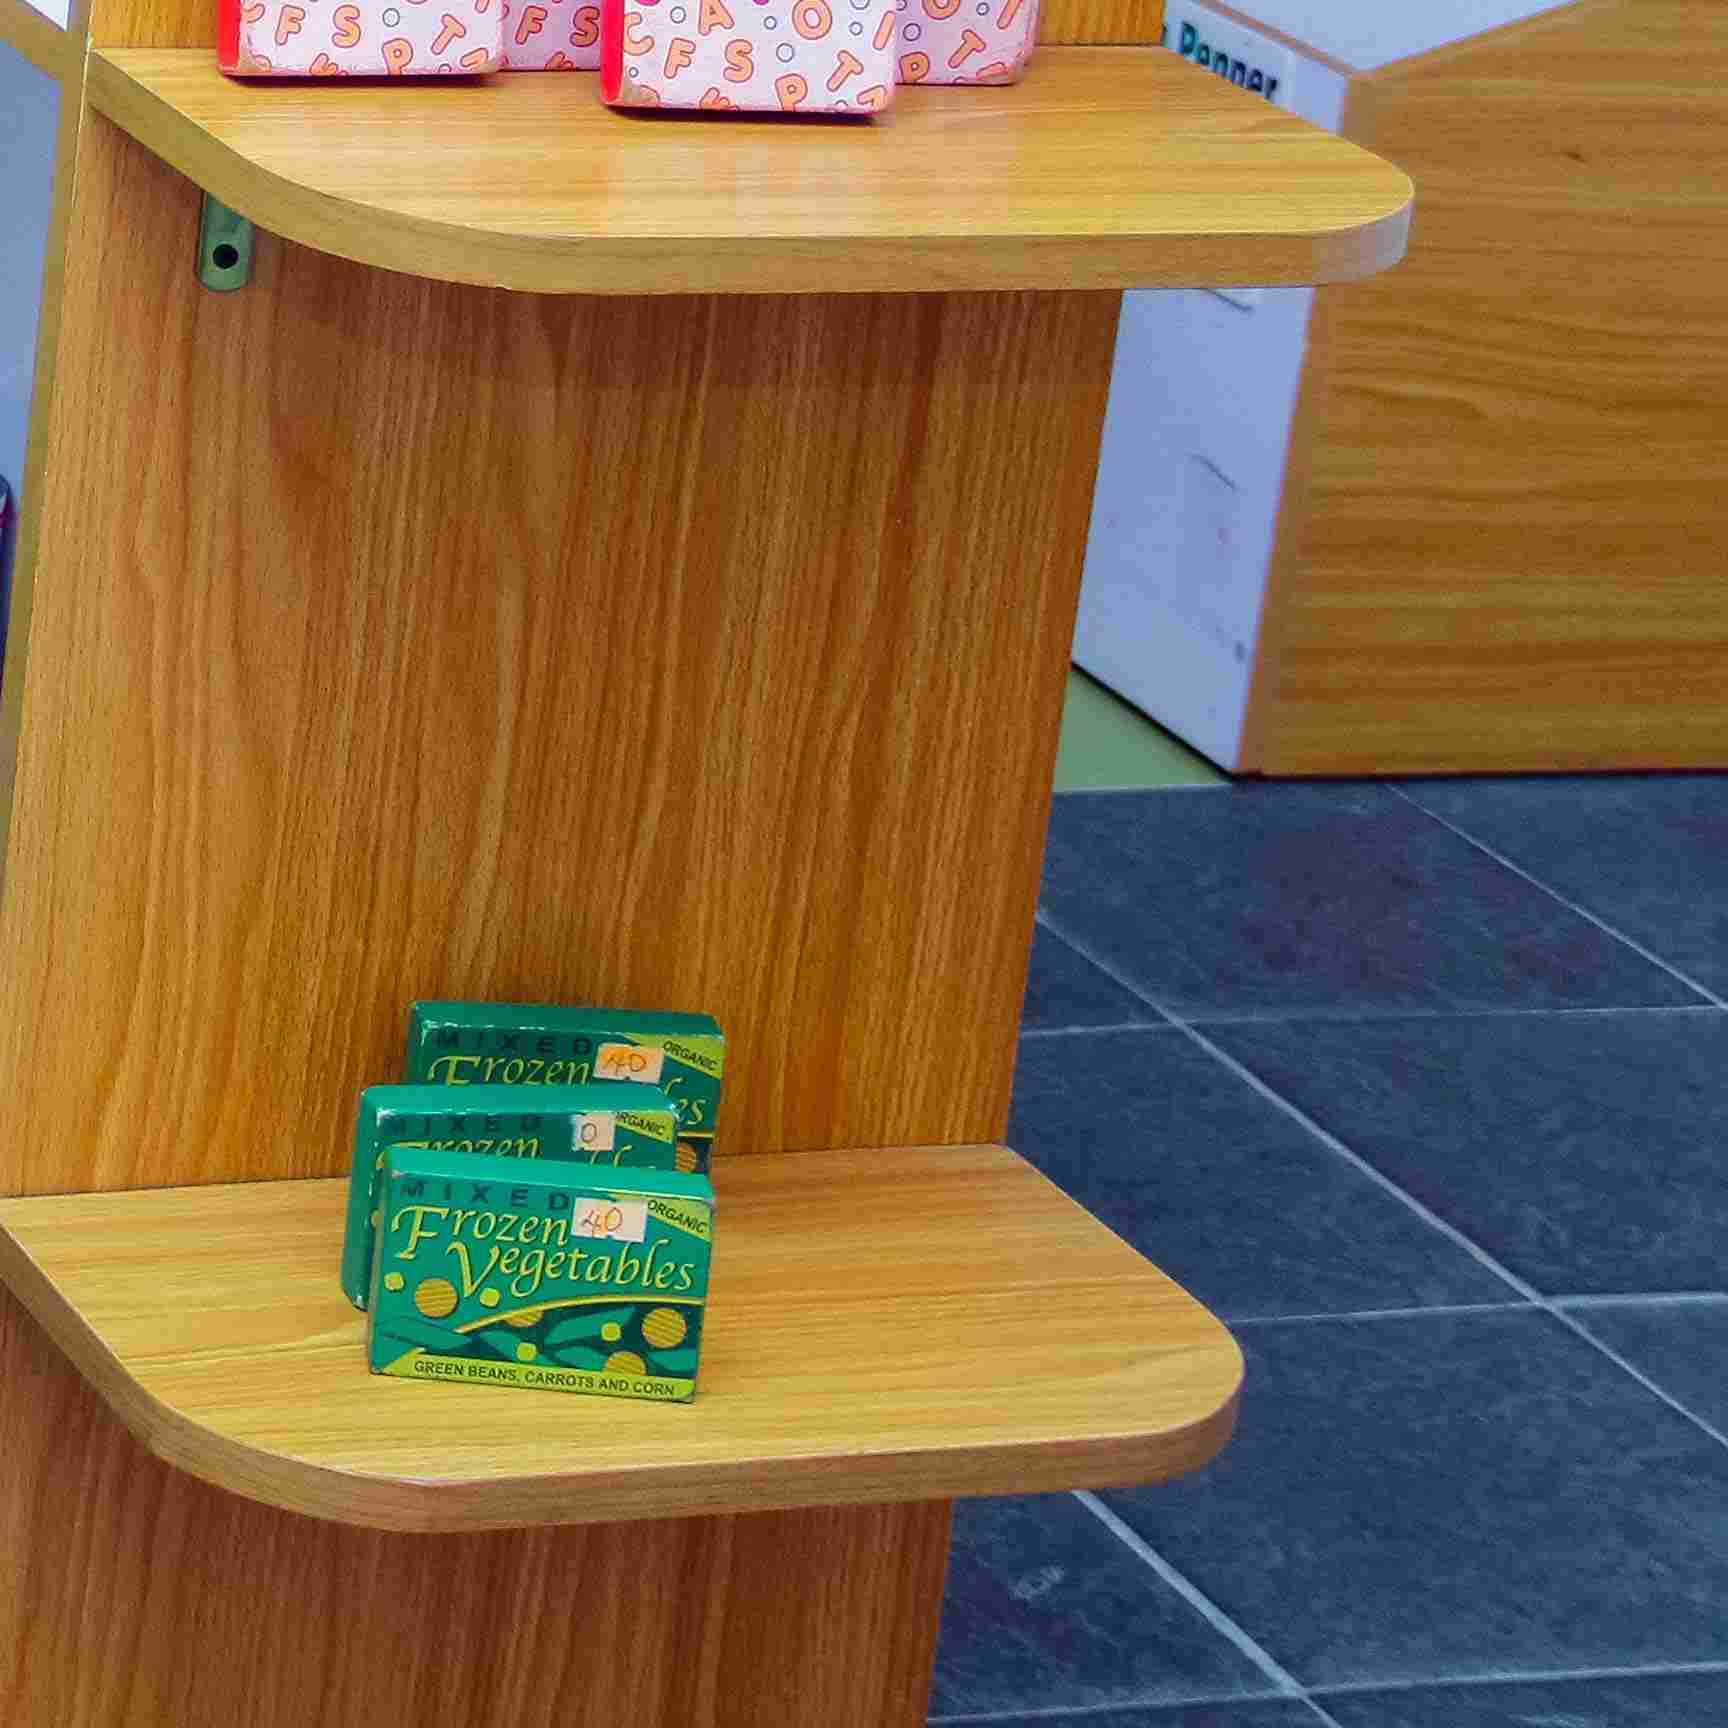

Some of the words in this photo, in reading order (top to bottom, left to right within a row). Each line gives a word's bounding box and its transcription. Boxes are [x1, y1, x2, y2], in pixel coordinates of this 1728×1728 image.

[435, 1031, 592, 1056] MIXED
[662, 1038, 719, 1071] ORGANIC
[427, 1054, 593, 1087] Frozen
[398, 1178, 571, 1212] MIXED
[391, 1203, 570, 1260] Frozen
[581, 1205, 625, 1235] 40
[647, 1199, 709, 1235] ORGANIC
[445, 1237, 696, 1298] Vegetables
[413, 1360, 465, 1377] GREEN
[467, 1363, 519, 1385] BEANS,
[523, 1369, 596, 1391] CARROTS
[597, 1377, 629, 1393] AND
[632, 1380, 675, 1397] CORN
